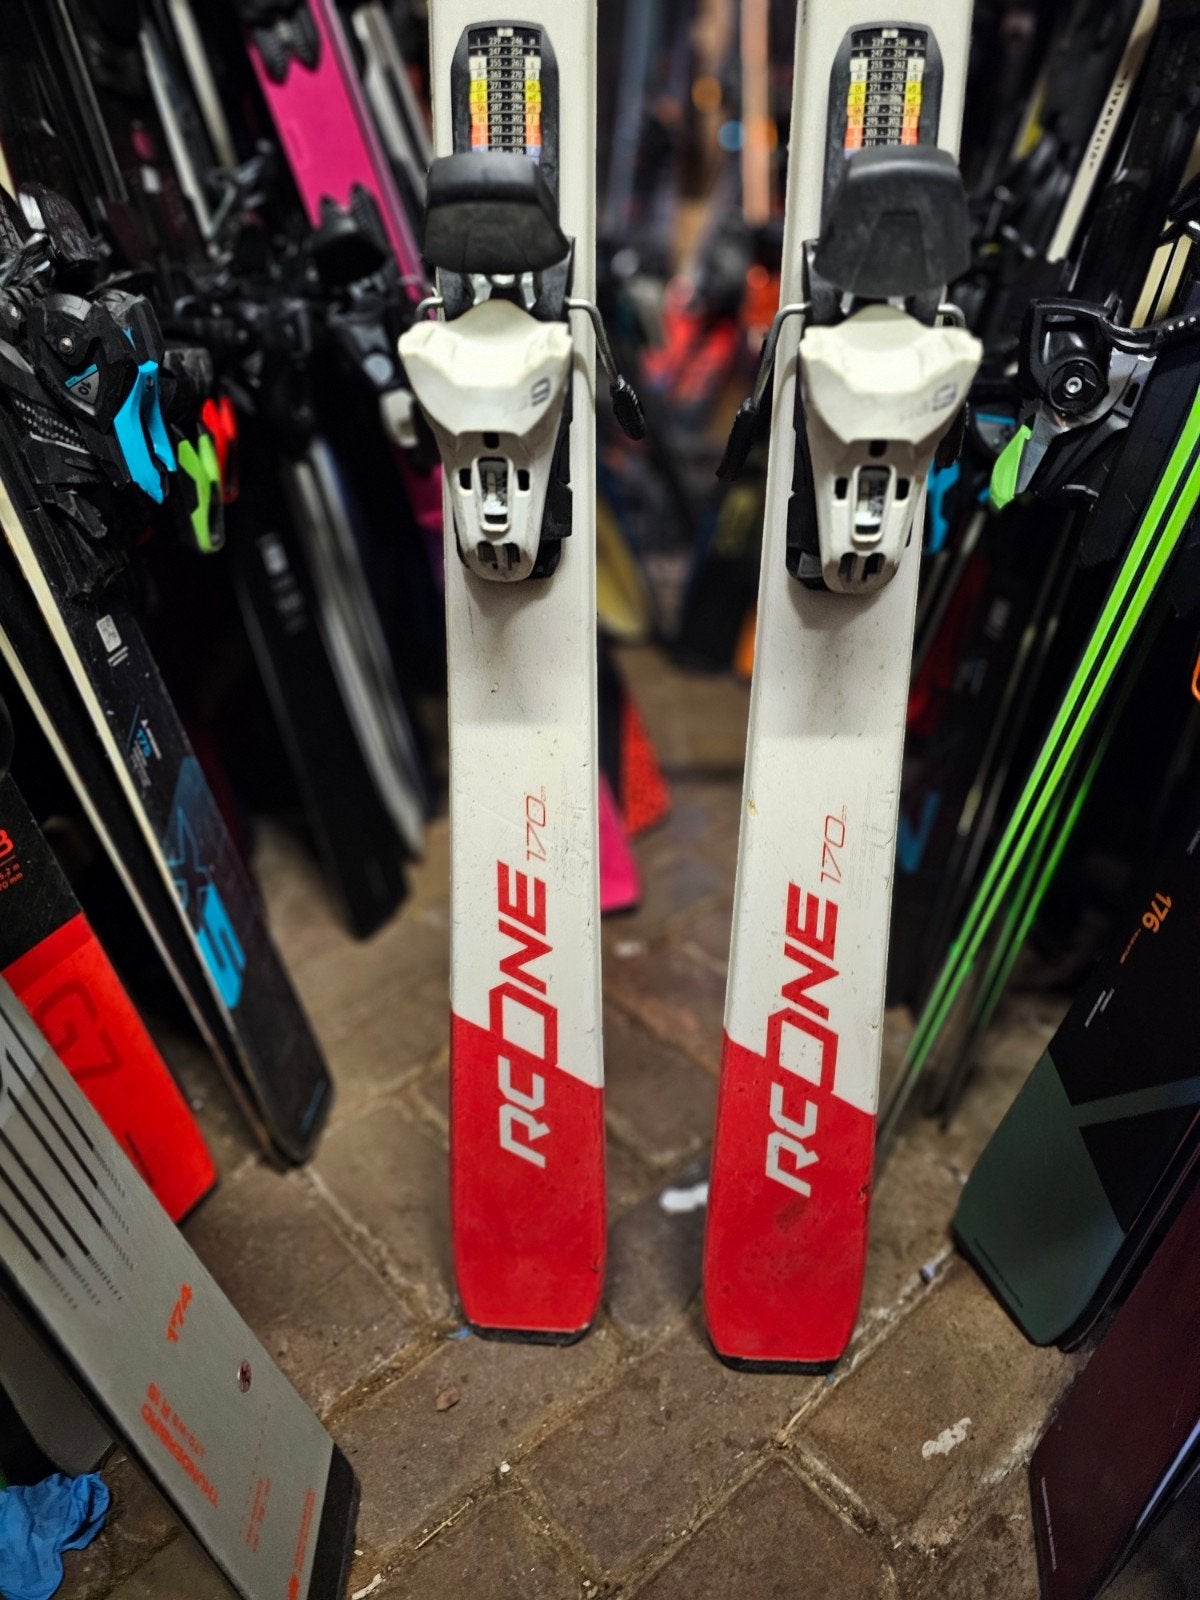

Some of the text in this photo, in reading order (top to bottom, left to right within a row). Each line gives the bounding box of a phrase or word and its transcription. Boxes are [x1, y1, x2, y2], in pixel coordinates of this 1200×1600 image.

[525, 794, 547, 862] 170
[820, 814, 846, 884] 170
[489, 859, 557, 1067] ONE
[1142, 892, 1172, 934] 176
[765, 881, 840, 1092] ONE
[497, 1055, 551, 1169] RC
[765, 1080, 820, 1198] RC
